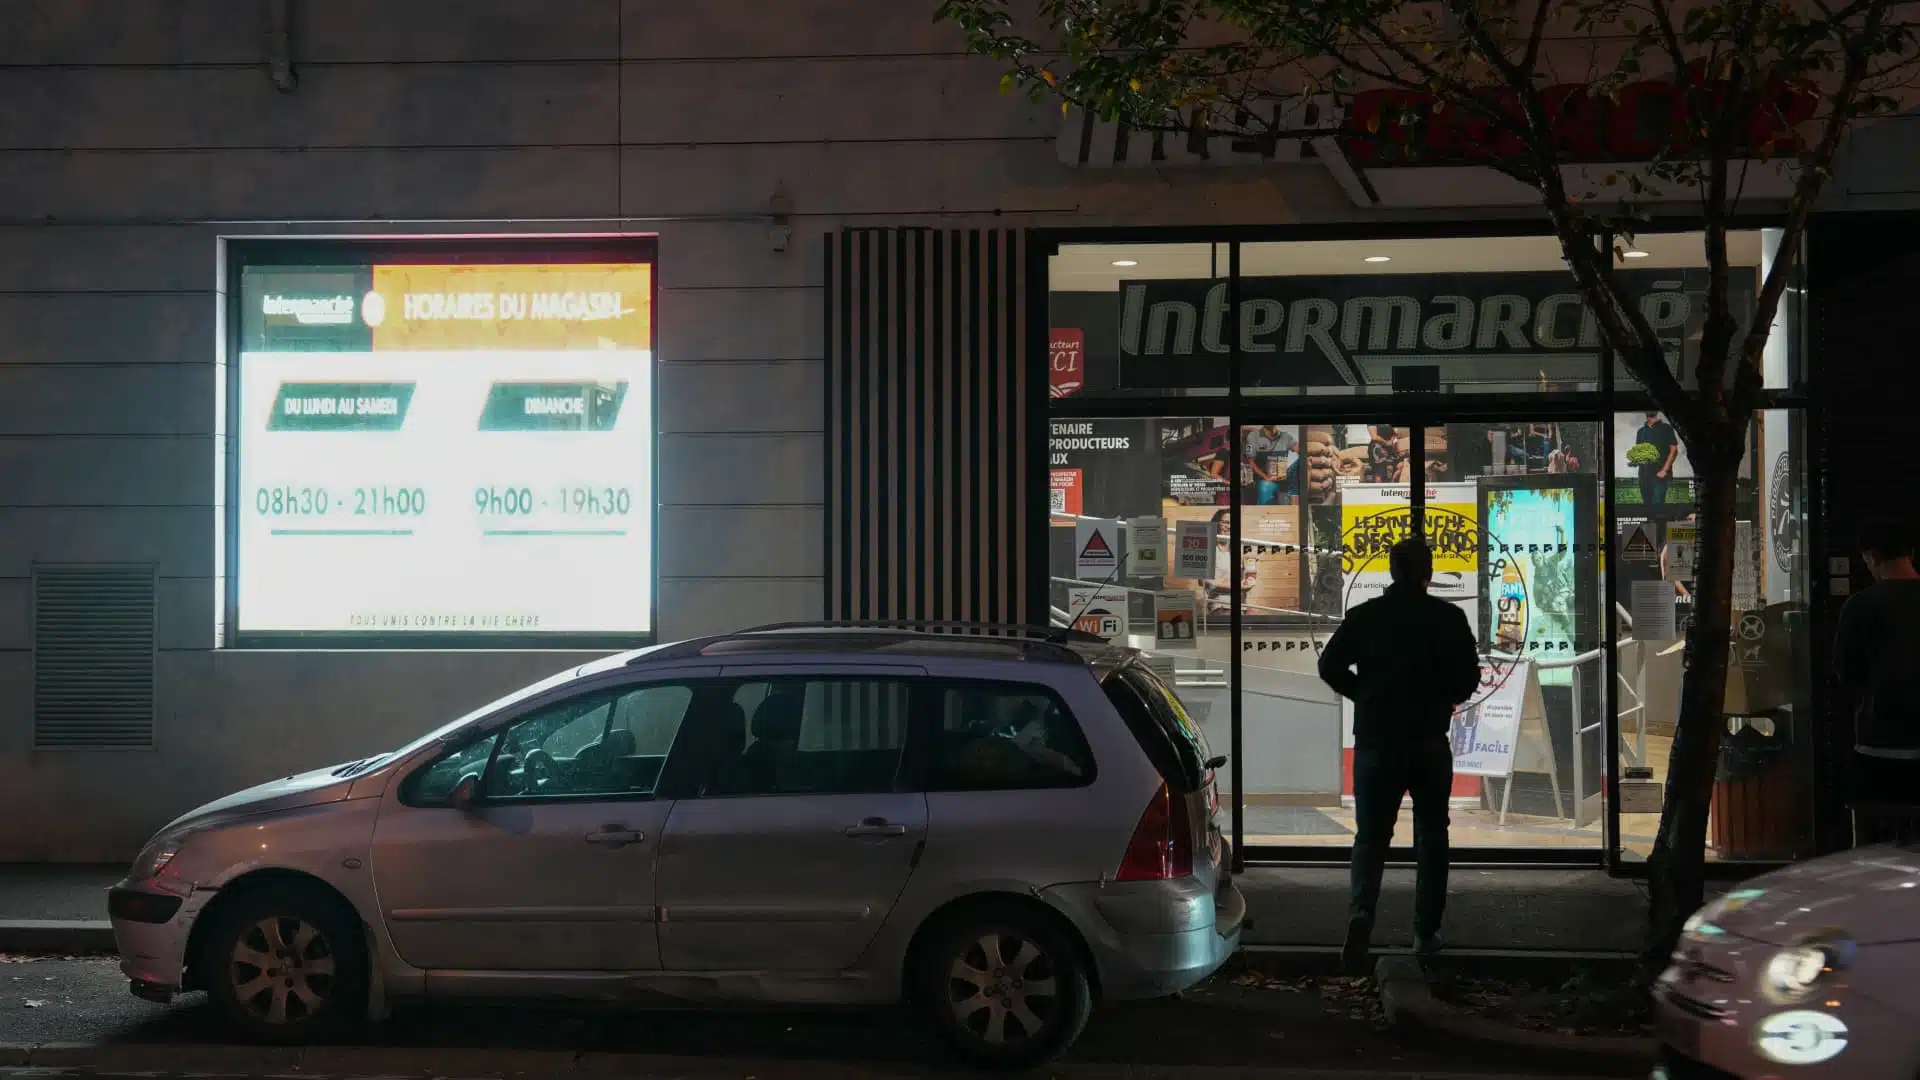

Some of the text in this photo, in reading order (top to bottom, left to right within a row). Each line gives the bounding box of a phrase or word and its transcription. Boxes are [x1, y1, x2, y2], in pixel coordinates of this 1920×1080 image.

[403, 290, 622, 321] HORAIRES DU MAGASIN
[285, 398, 397, 415] DU LUNDI AU SAMEDI
[525, 398, 584, 414] DIMANCHE
[1049, 423, 1093, 435] ENAIRE
[1049, 453, 1069, 465] UX
[257, 487, 328, 516] 08h30
[354, 487, 426, 516] 21h00
[475, 487, 533, 516] 9h00
[559, 487, 630, 516] 19h30
[1375, 514, 1466, 529] DIMNCHE
[383, 615, 409, 626] UNIS
[414, 615, 457, 626] CONTRE
[463, 615, 476, 626] LA
[481, 615, 500, 626] VIE
